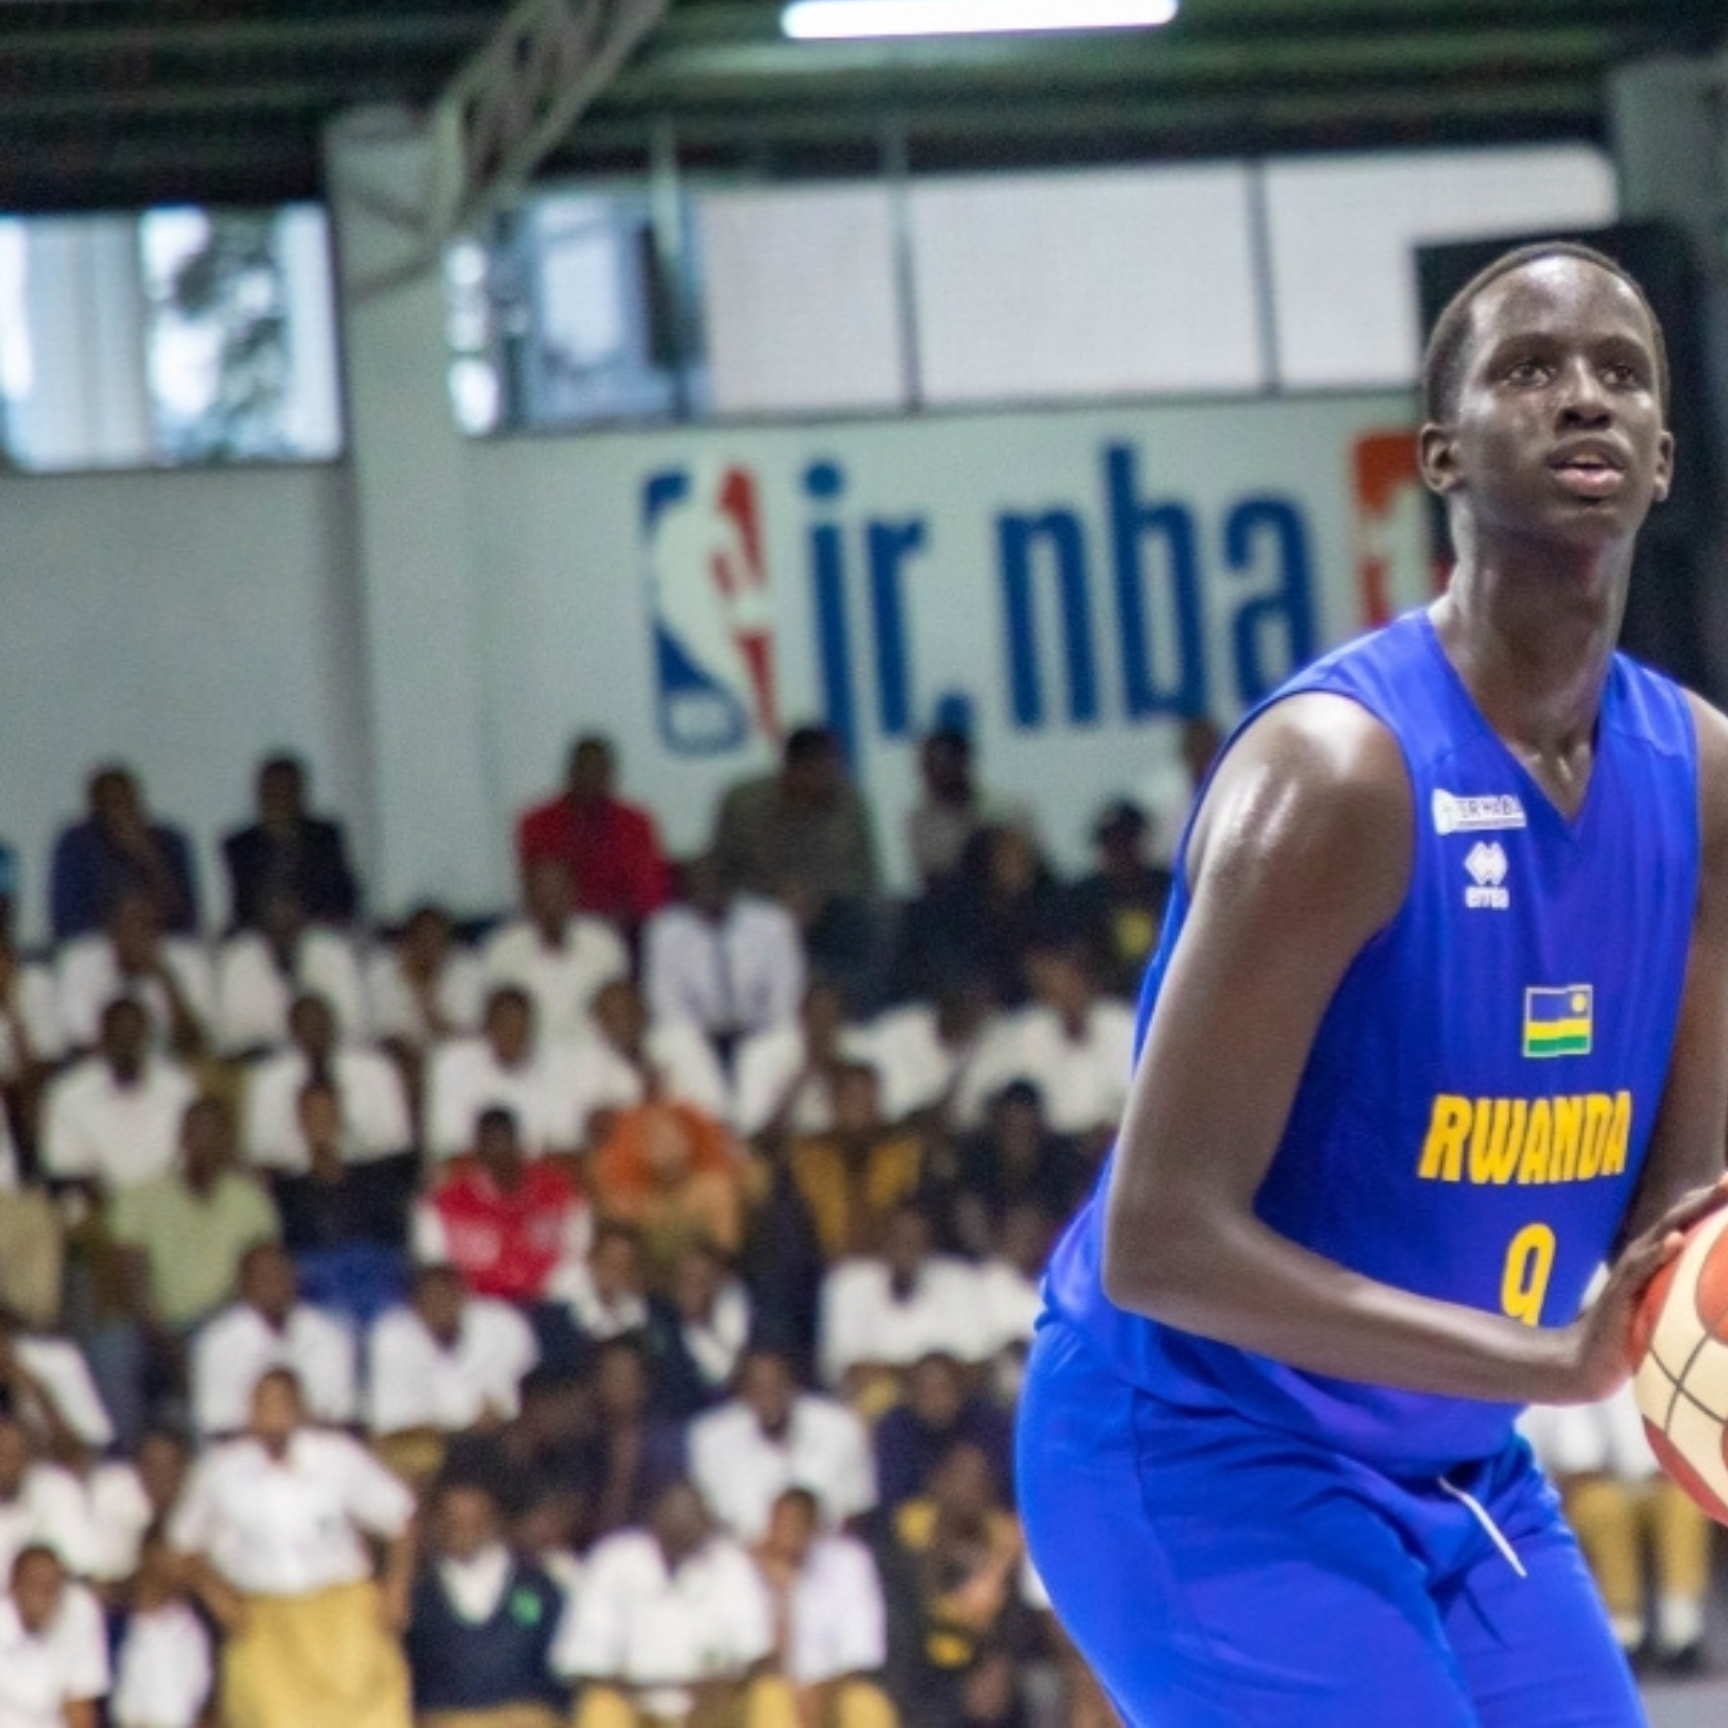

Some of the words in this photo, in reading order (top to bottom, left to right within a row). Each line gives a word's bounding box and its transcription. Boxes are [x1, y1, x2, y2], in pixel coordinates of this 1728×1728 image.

[998, 440, 1316, 733] nba
[1417, 1091, 1632, 1185] RWANDA
[1502, 1222, 1556, 1328] 9
